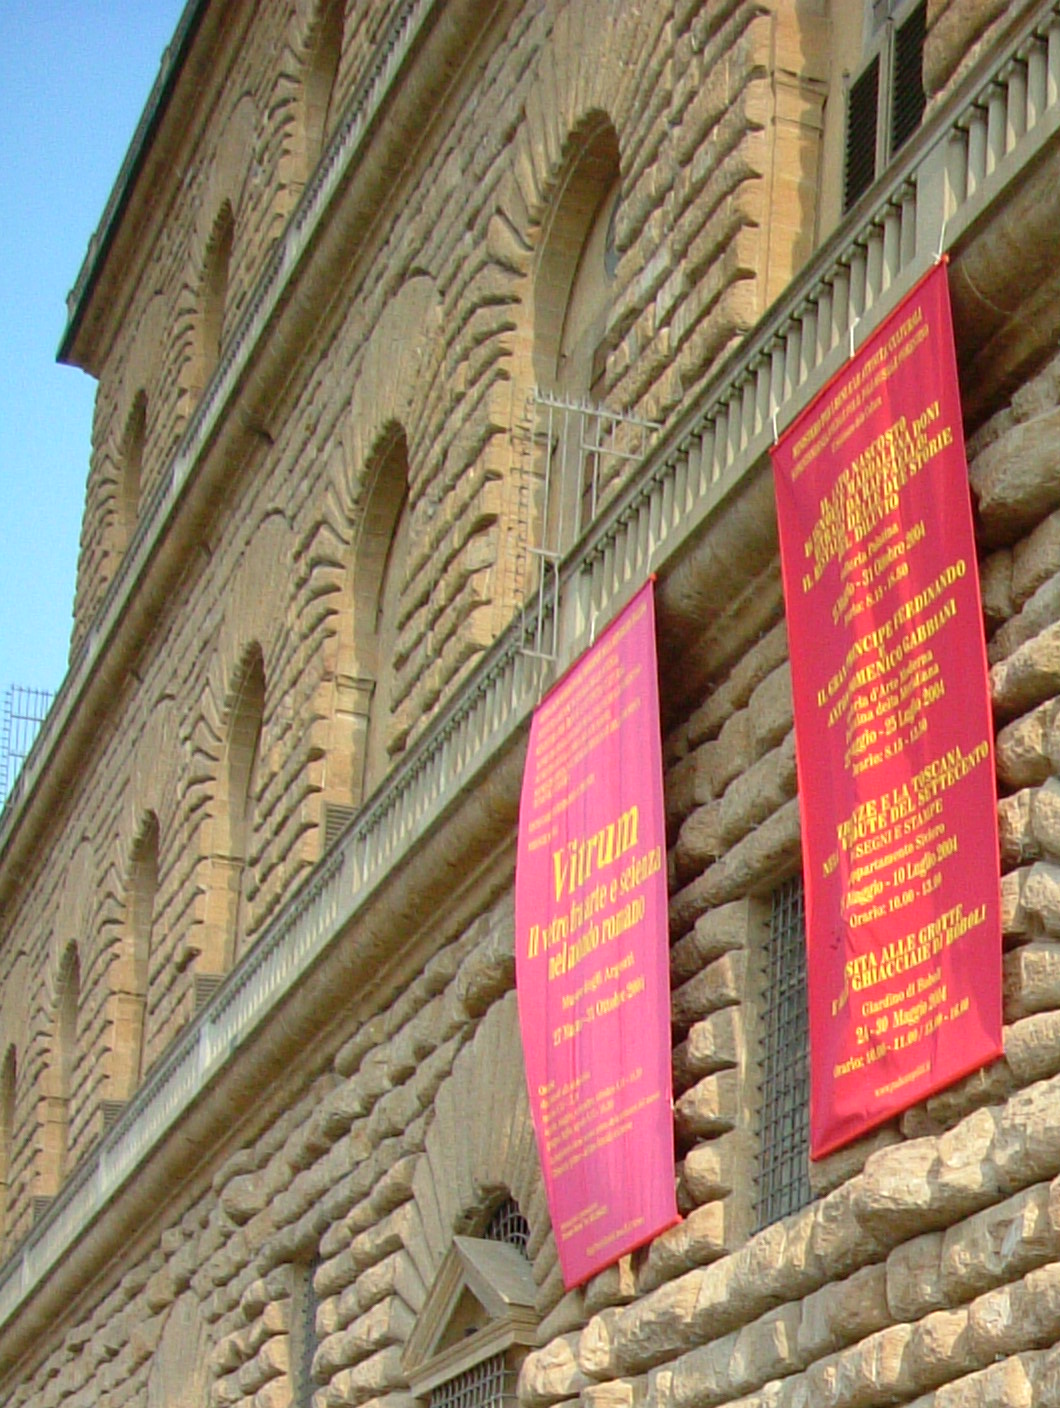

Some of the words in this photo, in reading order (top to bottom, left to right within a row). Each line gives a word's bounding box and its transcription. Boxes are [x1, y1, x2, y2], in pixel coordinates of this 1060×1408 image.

[893, 559, 966, 630] FERDINANDO
[902, 598, 957, 654] GABBIANI
[890, 797, 915, 822] DEL
[917, 740, 989, 807] SETTECENTO
[912, 745, 962, 792] TOSCANA
[554, 805, 639, 903] Vitrum
[893, 867, 906, 886] 10
[528, 924, 540, 959] Il
[610, 879, 618, 903] e
[620, 846, 661, 895] scienza
[601, 895, 645, 944] romano
[881, 934, 915, 962] ALLE
